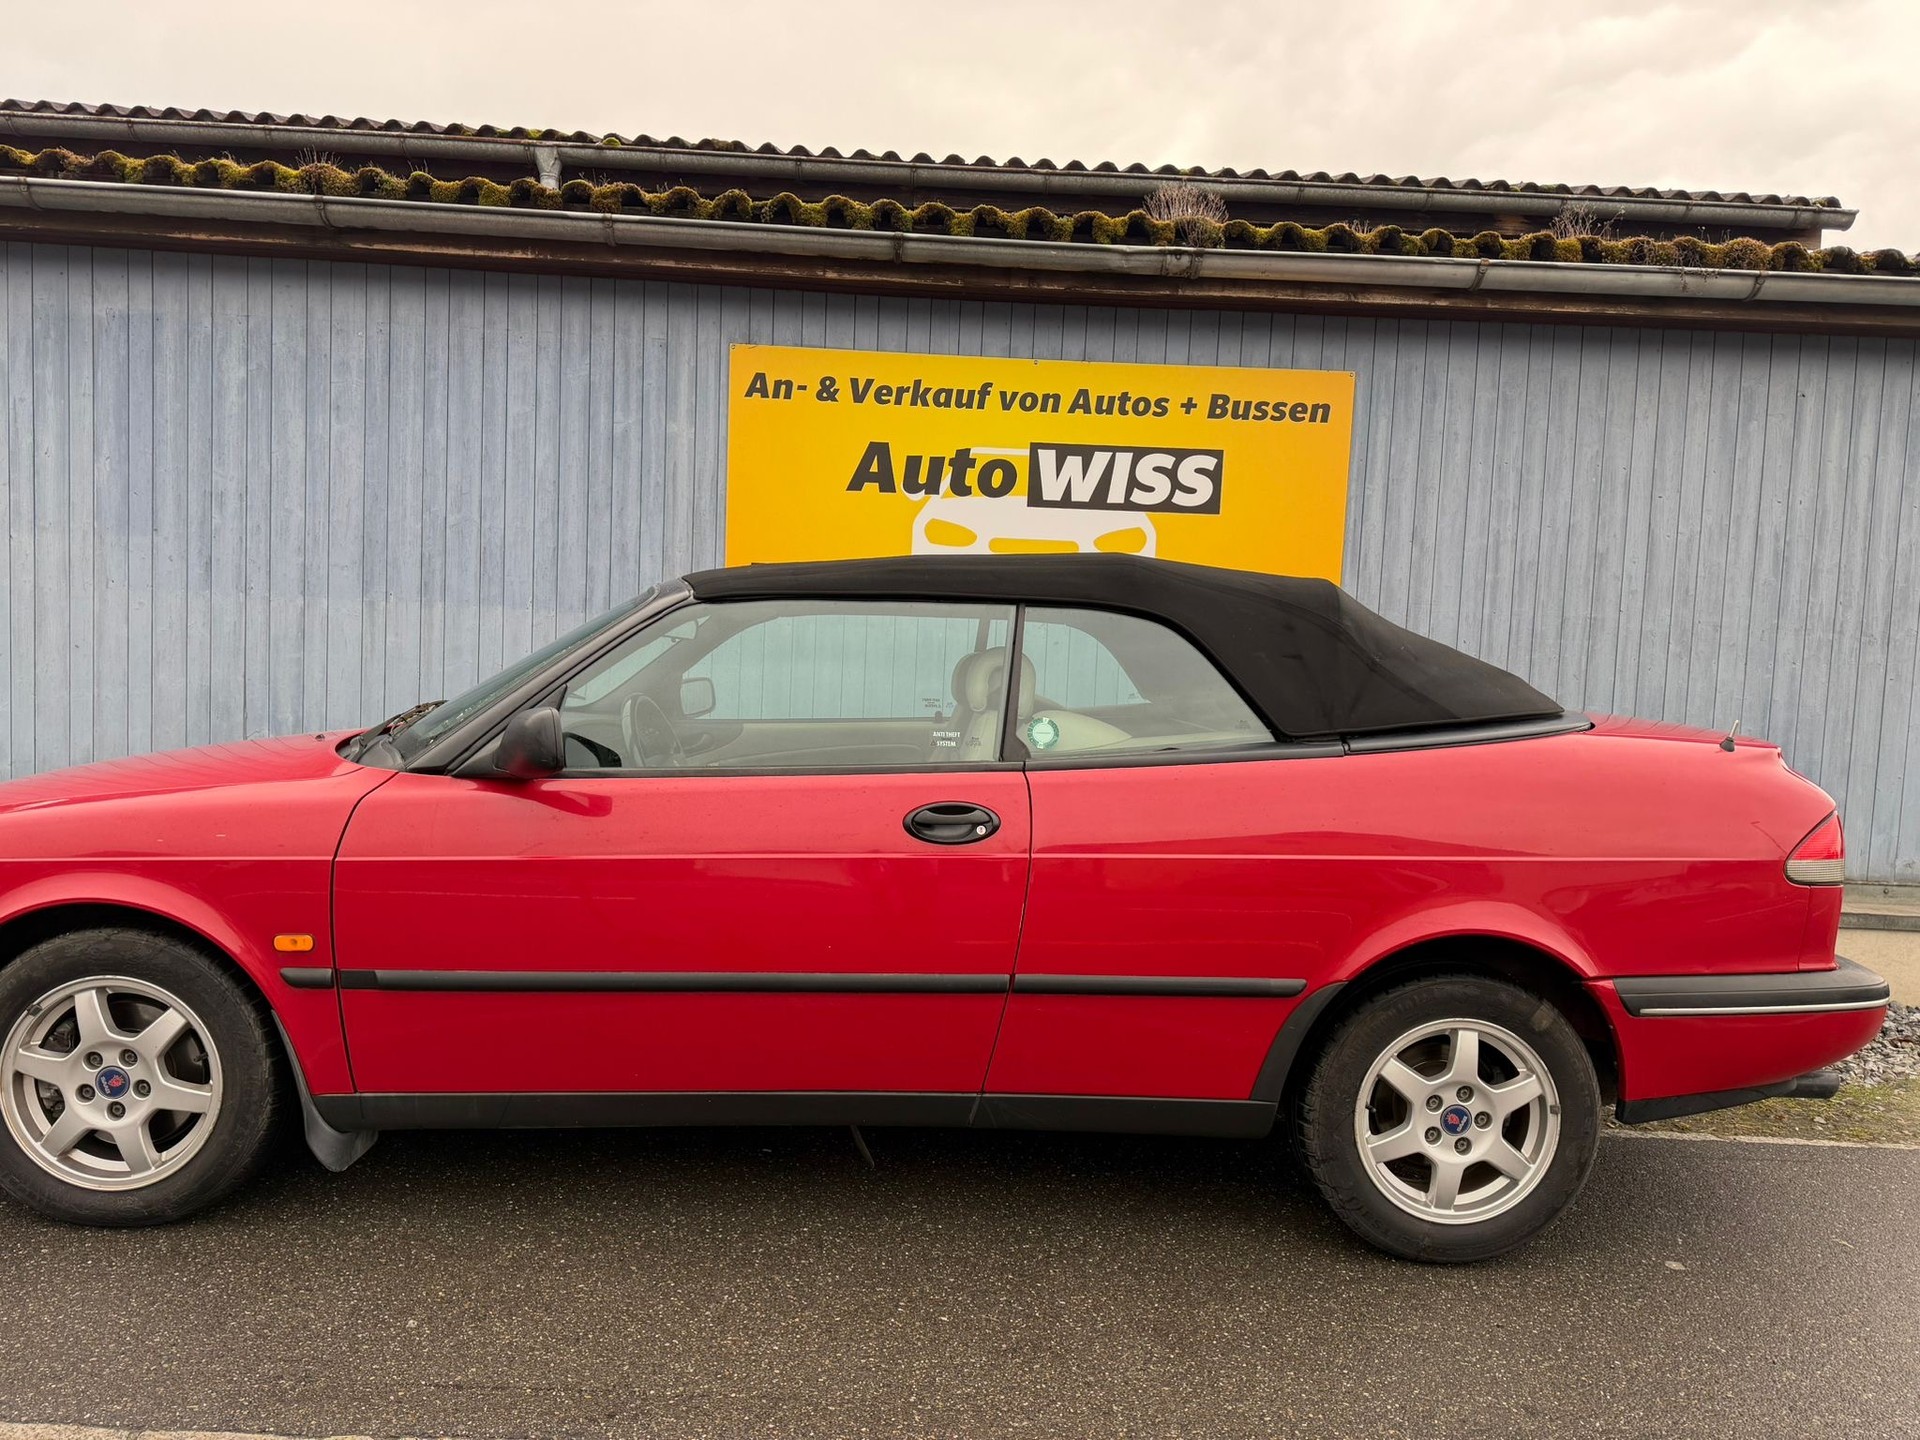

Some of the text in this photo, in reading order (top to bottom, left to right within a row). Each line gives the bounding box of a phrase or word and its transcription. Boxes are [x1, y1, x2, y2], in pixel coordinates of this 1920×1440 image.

[744, 372, 1331, 424] An- & Verkauf von Autos + Bussen
[846, 441, 1218, 507] Auto WISS
